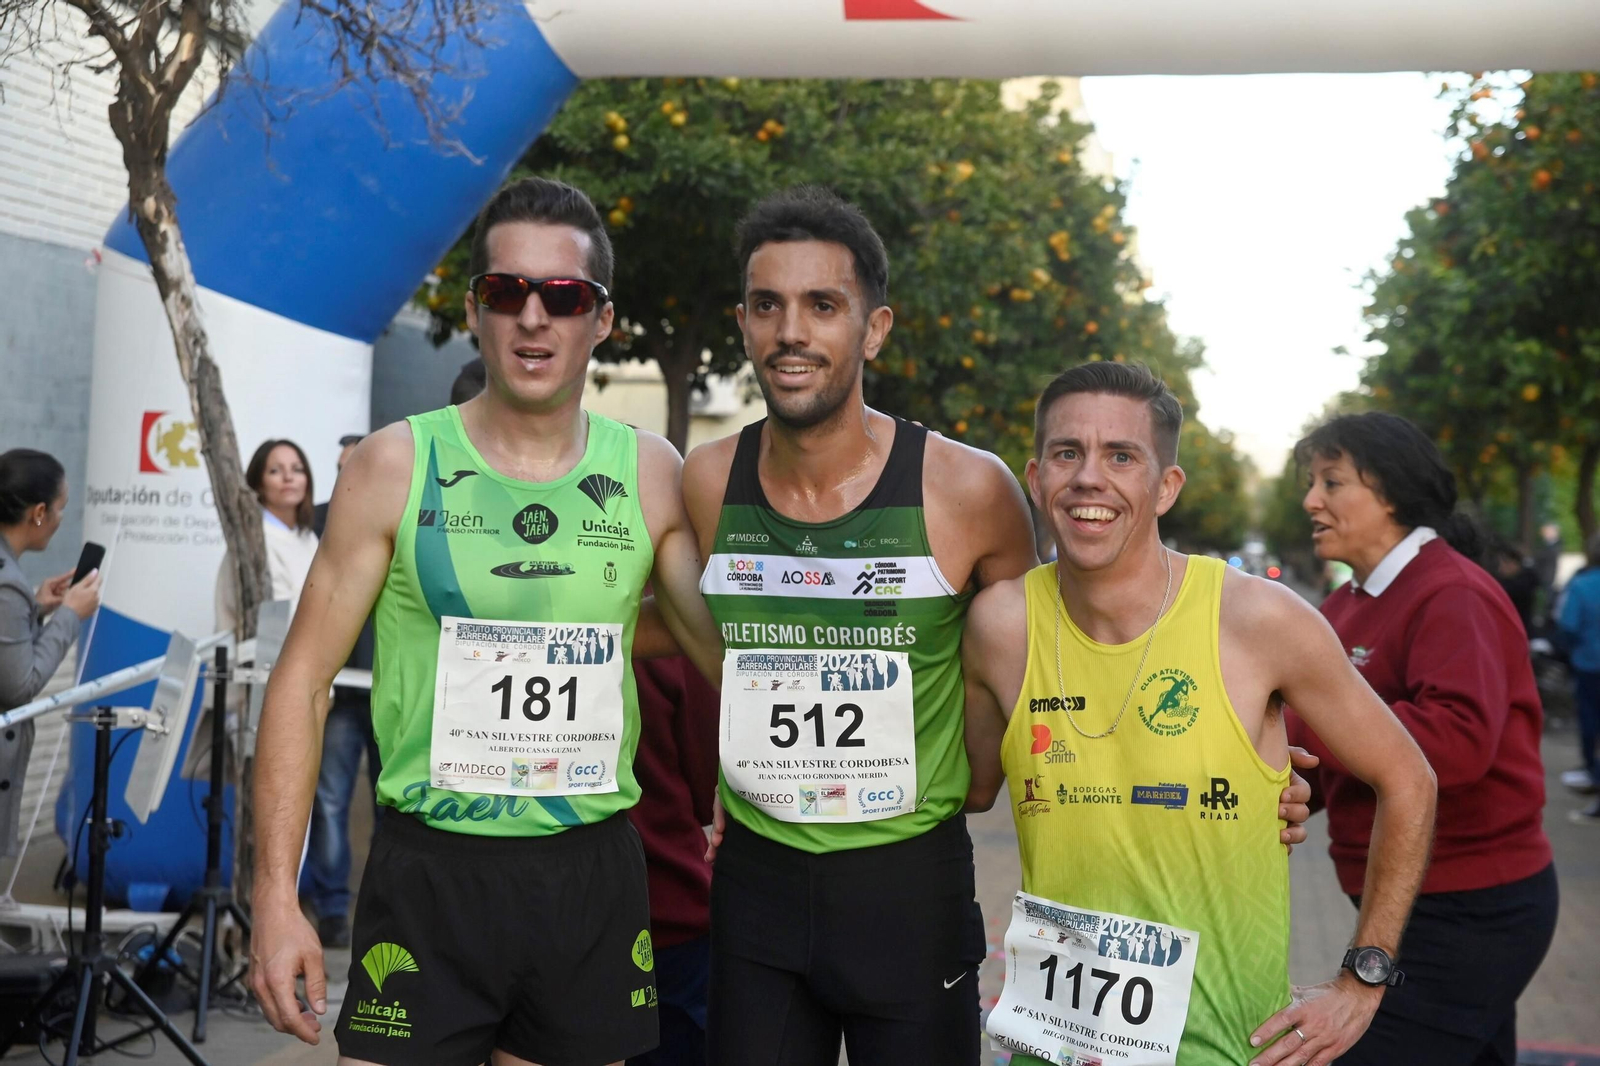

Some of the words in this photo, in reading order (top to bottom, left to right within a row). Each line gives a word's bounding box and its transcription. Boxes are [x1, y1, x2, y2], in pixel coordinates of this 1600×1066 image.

[165, 487, 192, 508] de
[438, 510, 483, 528] Jaén
[582, 520, 629, 538] Unicaja
[578, 539, 618, 549] Fundación
[620, 542, 635, 551] Jaén
[736, 534, 770, 543] IMDECO
[858, 538, 876, 548] LSC
[727, 571, 764, 582] CÓRDOBA
[875, 585, 902, 595] CAC
[456, 624, 492, 632] CIRCUITO
[492, 626, 536, 635] PROVINCIAL
[548, 628, 588, 644] 2024
[722, 622, 806, 648] ATLETISMO
[814, 622, 916, 646] CORDOBÉS
[455, 640, 497, 648] DIPUTACIÓN
[456, 632, 499, 642] CARRERAS
[500, 634, 546, 644] POPULARES
[820, 654, 864, 672] 2024
[1140, 672, 1158, 691] CLUB
[1160, 668, 1198, 691] ATLETISMO
[491, 674, 578, 722] 181
[769, 703, 866, 748] 512
[1138, 706, 1164, 736] RUNNERS
[1166, 726, 1187, 736] PURA
[1187, 707, 1200, 727] CEPA
[467, 731, 489, 740] SAN
[491, 732, 552, 742] SILVESTRE
[556, 732, 616, 742] CORDOBESA
[1052, 740, 1066, 752] DS
[753, 760, 774, 769] SAN
[776, 760, 837, 769] SILVESTRE
[839, 757, 910, 768] CORDOBESA
[1044, 751, 1076, 764] Smith
[454, 763, 506, 776] IMDECO
[575, 765, 598, 775] GCC
[748, 791, 794, 804] IMDECO
[868, 790, 895, 801] GCC
[1069, 795, 1079, 803] EL
[1083, 794, 1122, 804] MONTE
[1200, 812, 1238, 820] RIADA
[1051, 908, 1089, 923] PROVINCIAL
[1090, 916, 1100, 924] DE
[1057, 918, 1100, 933] POPULARES
[1100, 918, 1148, 941] 2024
[646, 986, 657, 1002] Ja
[1039, 954, 1154, 1026] 1170
[356, 998, 407, 1020] Unicaja
[349, 1021, 386, 1036] Fundación
[387, 1024, 411, 1038] Jaén
[1026, 1009, 1047, 1022] SAN
[1048, 1015, 1098, 1040] SILVESTRE
[1100, 1032, 1170, 1054] CORDOBESA
[1007, 1038, 1051, 1062] IMDECO
[1042, 1028, 1066, 1041] DIEGO
[1066, 1035, 1089, 1049] TIRADO
[1090, 1044, 1129, 1059] PALACIOS
